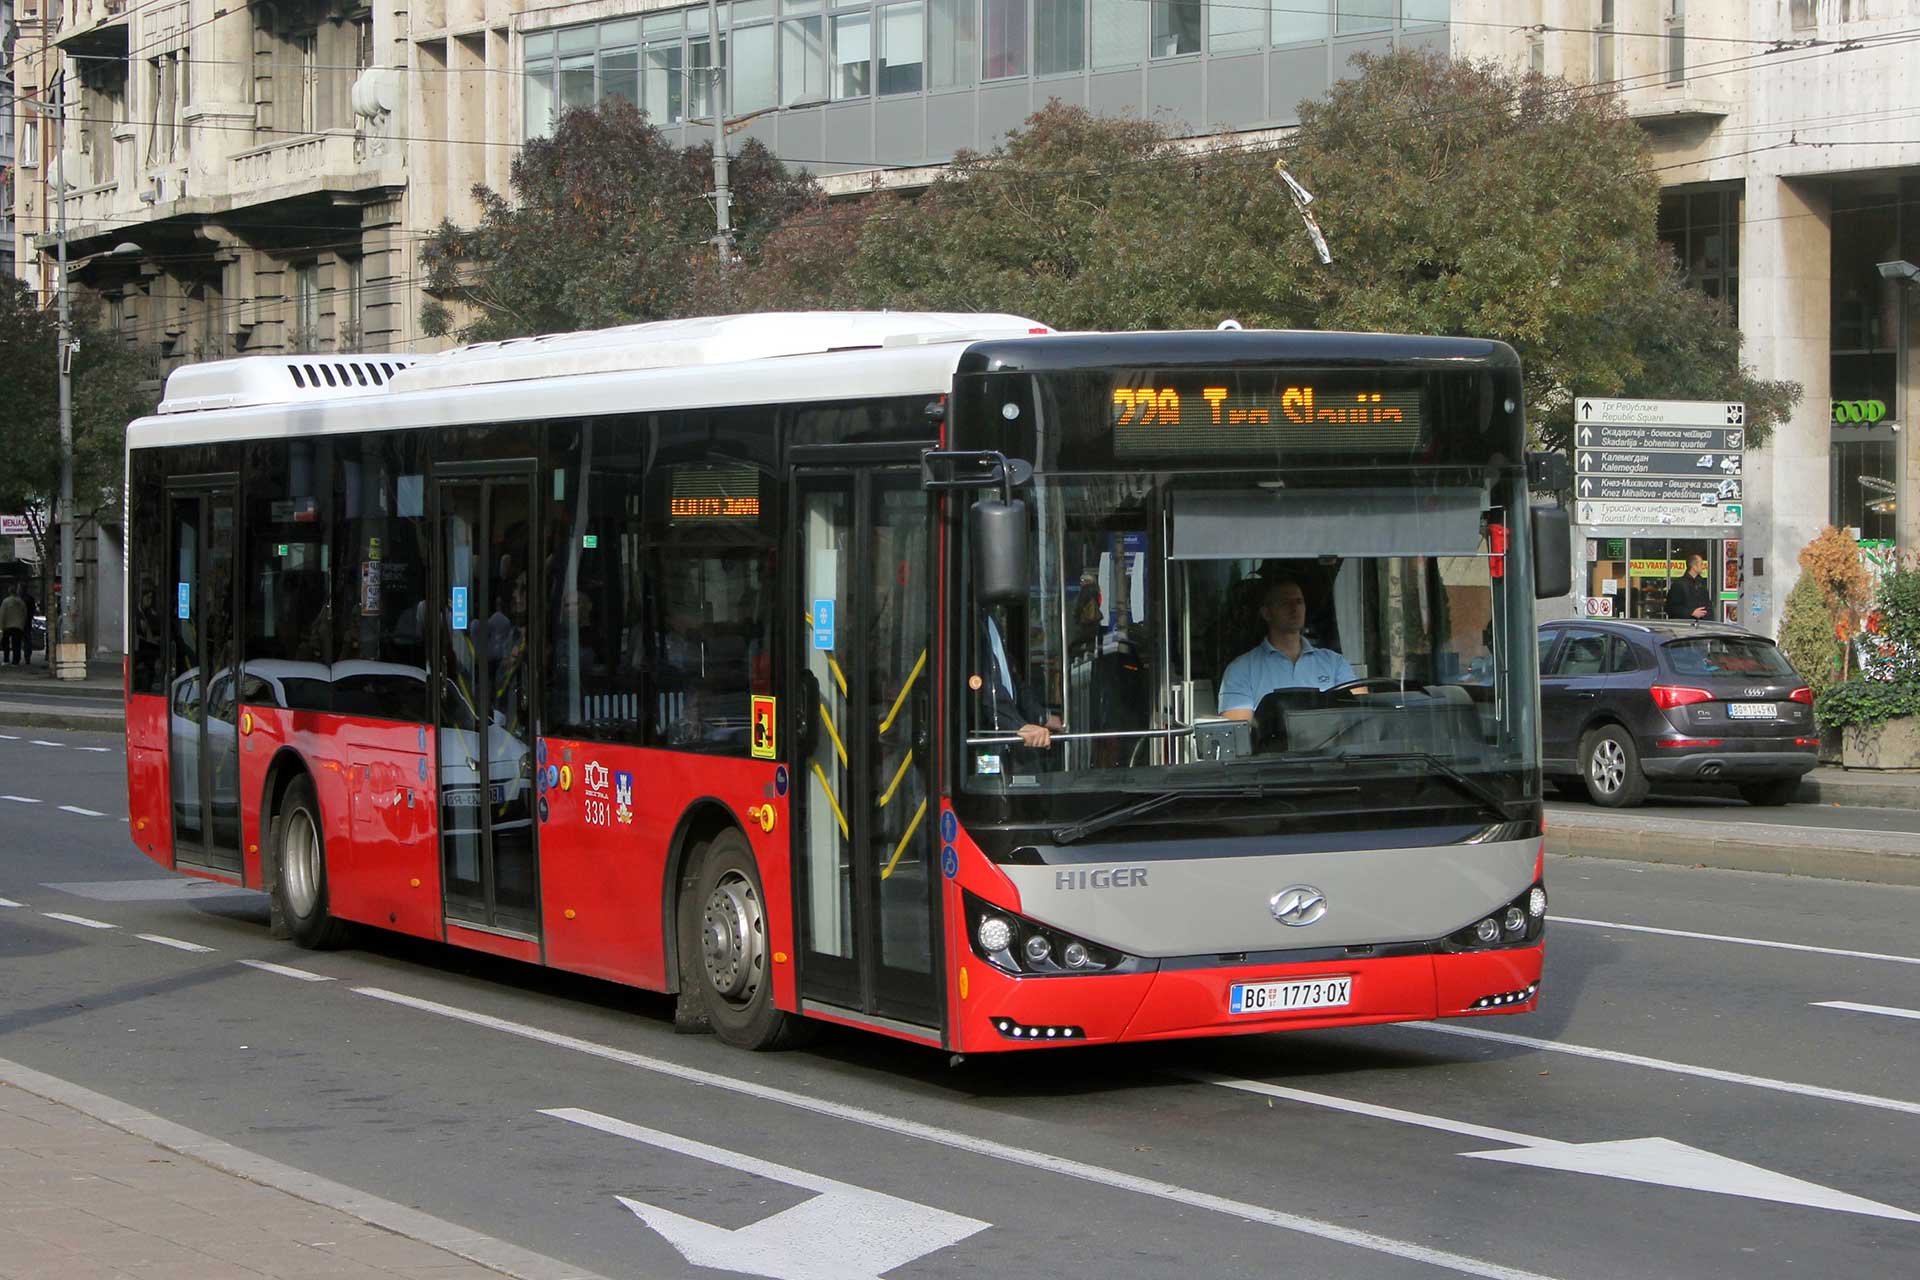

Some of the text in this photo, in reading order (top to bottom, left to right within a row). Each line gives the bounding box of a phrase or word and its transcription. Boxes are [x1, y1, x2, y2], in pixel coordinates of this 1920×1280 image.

[1831, 400, 1887, 423] OOD
[1602, 412, 1664, 424] Republic Square
[1601, 438, 1638, 448] Skadarlija
[1643, 439, 1679, 447] bohemian
[1681, 440, 1707, 449] quarter
[1601, 462, 1649, 473] Kalemegdan
[1601, 488, 1620, 497] Knez
[1622, 489, 1656, 498] Mihailova
[1662, 489, 1701, 499] pedestrian
[1601, 513, 1625, 522] Tourist
[1630, 561, 1667, 569] PAZI VRATA
[1670, 561, 1685, 569] PAZI
[584, 799, 611, 827] 3381
[1055, 867, 1150, 890] HIGER
[1245, 987, 1267, 1009] BG
